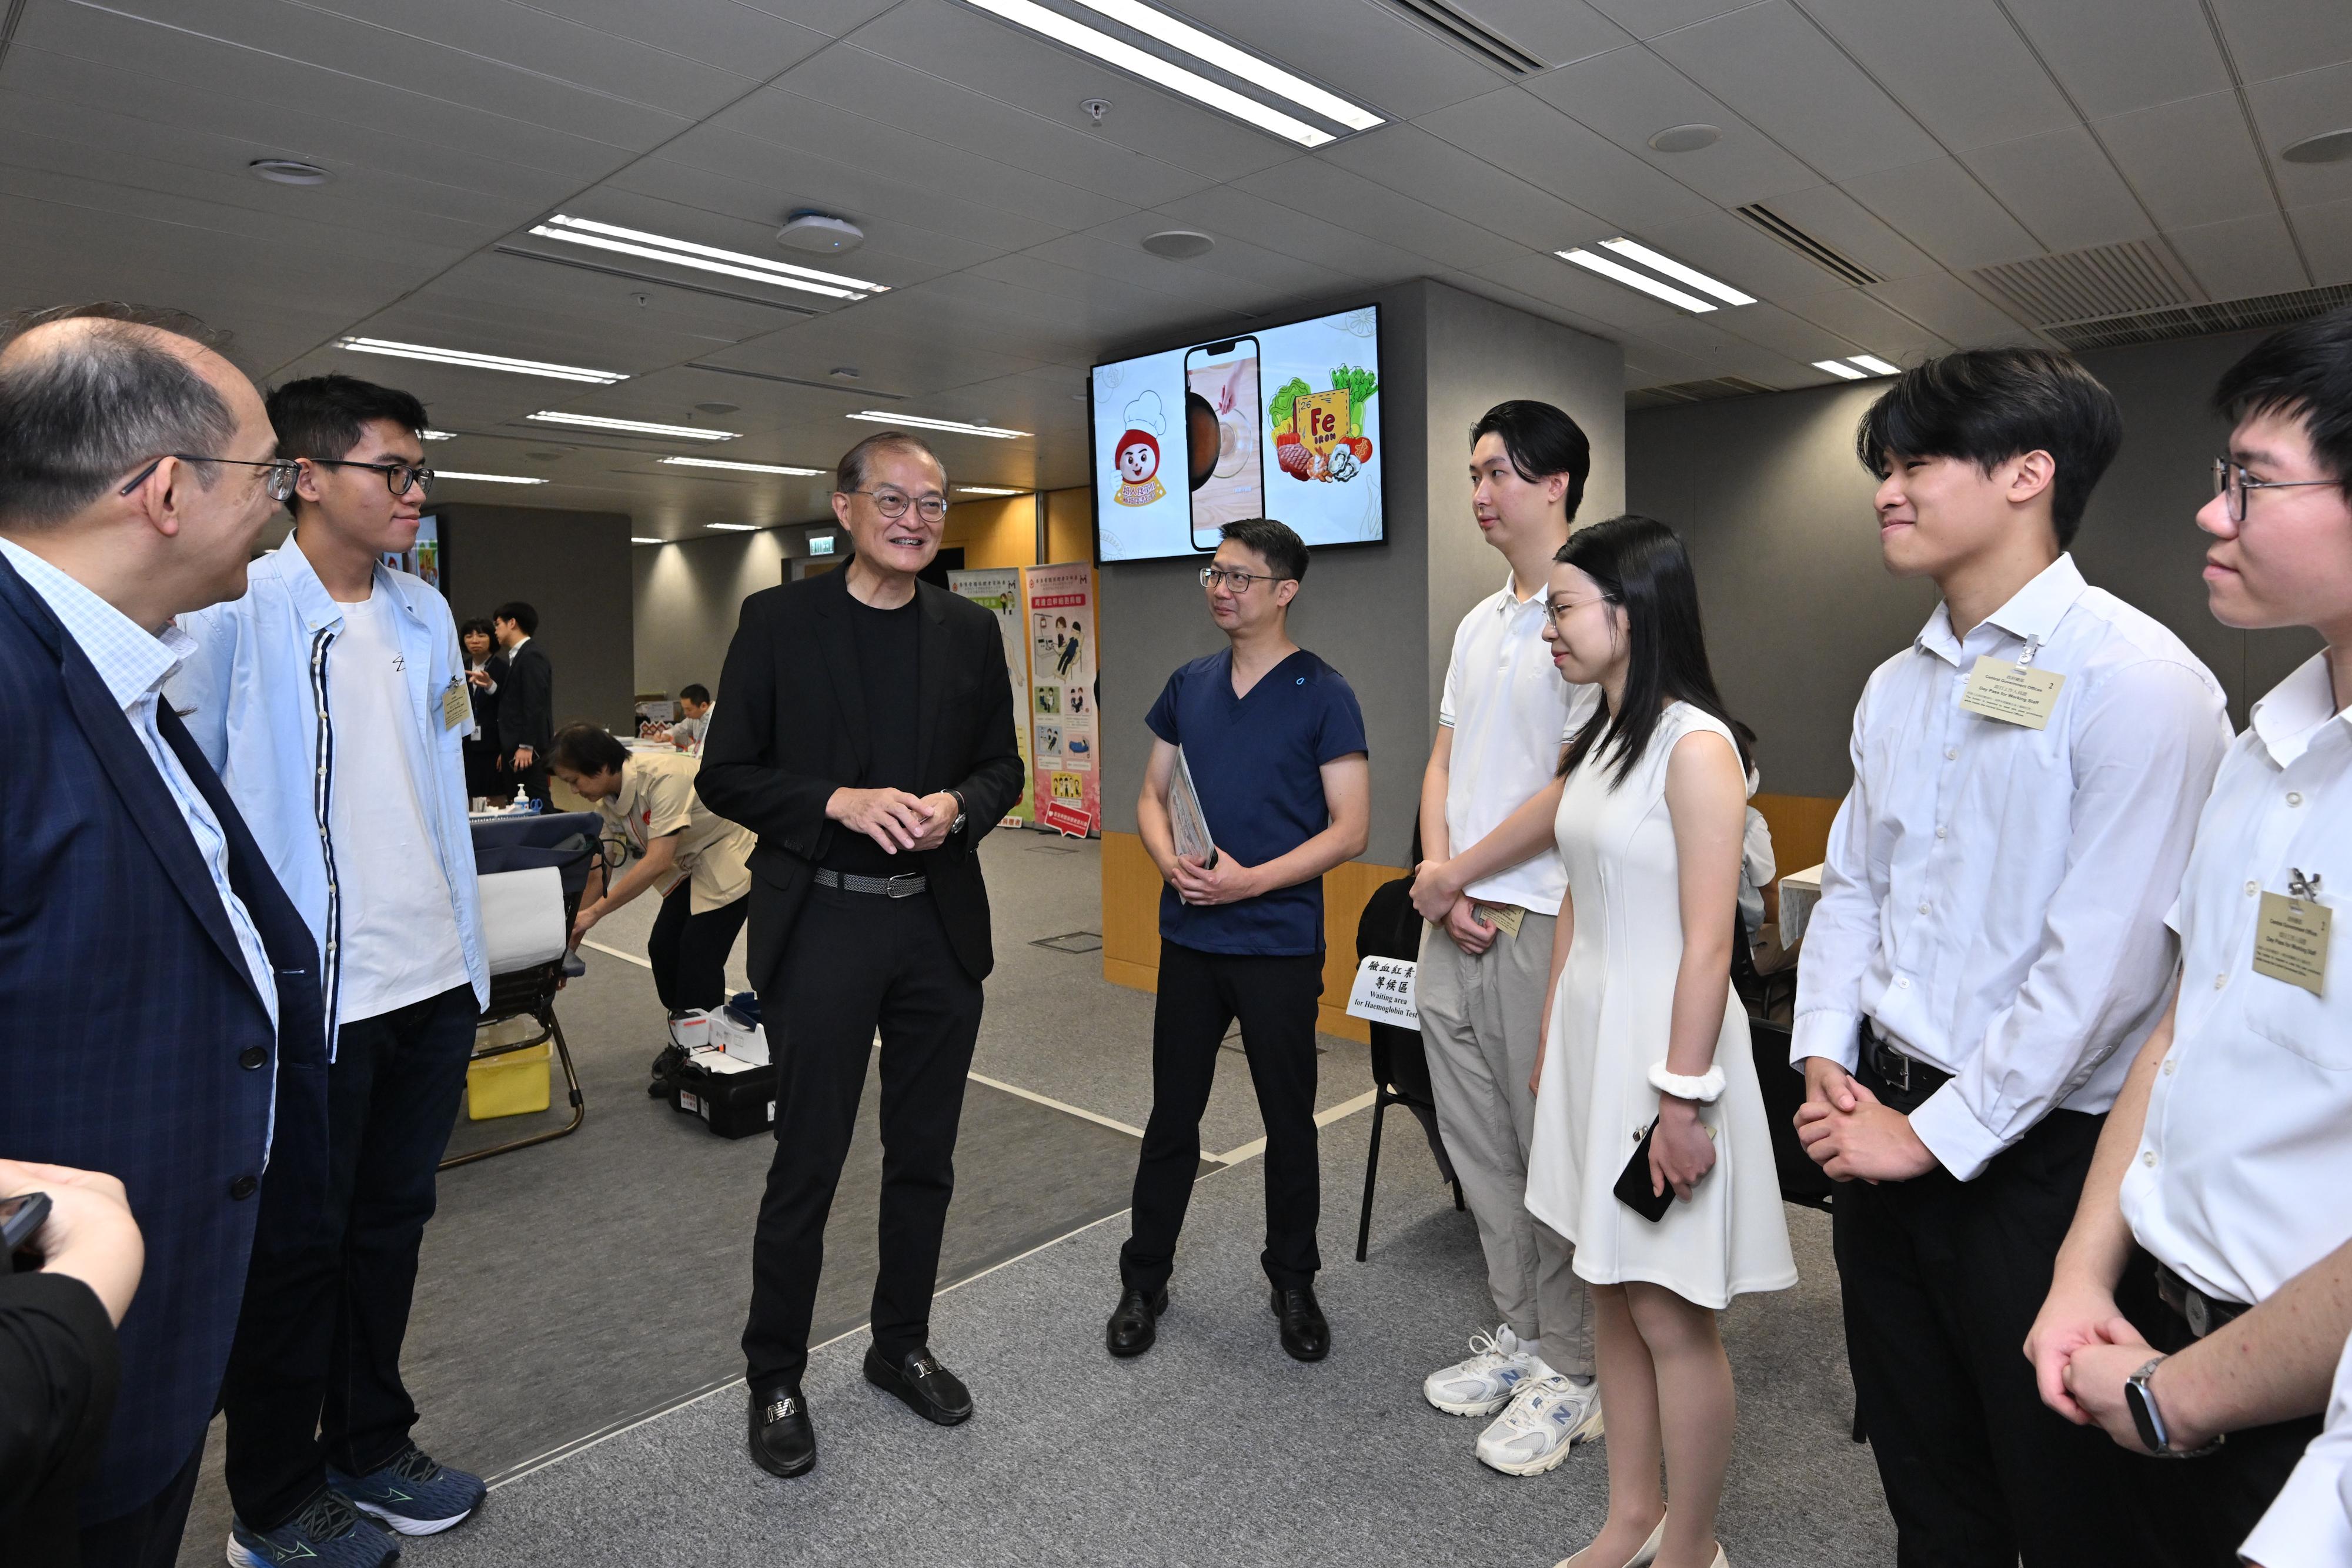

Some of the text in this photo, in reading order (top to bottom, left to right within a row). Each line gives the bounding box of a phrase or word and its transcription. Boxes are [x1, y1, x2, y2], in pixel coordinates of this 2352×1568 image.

[1301, 400, 1311, 410] 26
[1311, 407, 1335, 436] Fe
[1314, 433, 1336, 444] IRON
[2001, 678, 2026, 688] Government
[2008, 693, 2027, 703] Working
[1368, 961, 1416, 978] 驗血紅素
[1375, 976, 1409, 993] 等候區
[1370, 991, 1407, 1005] Waiting area
[1365, 1000, 1404, 1015] Haemoglobin
[1405, 1009, 1418, 1018] Test
[1500, 1369, 1521, 1387] N
[1552, 1406, 1572, 1426] N
